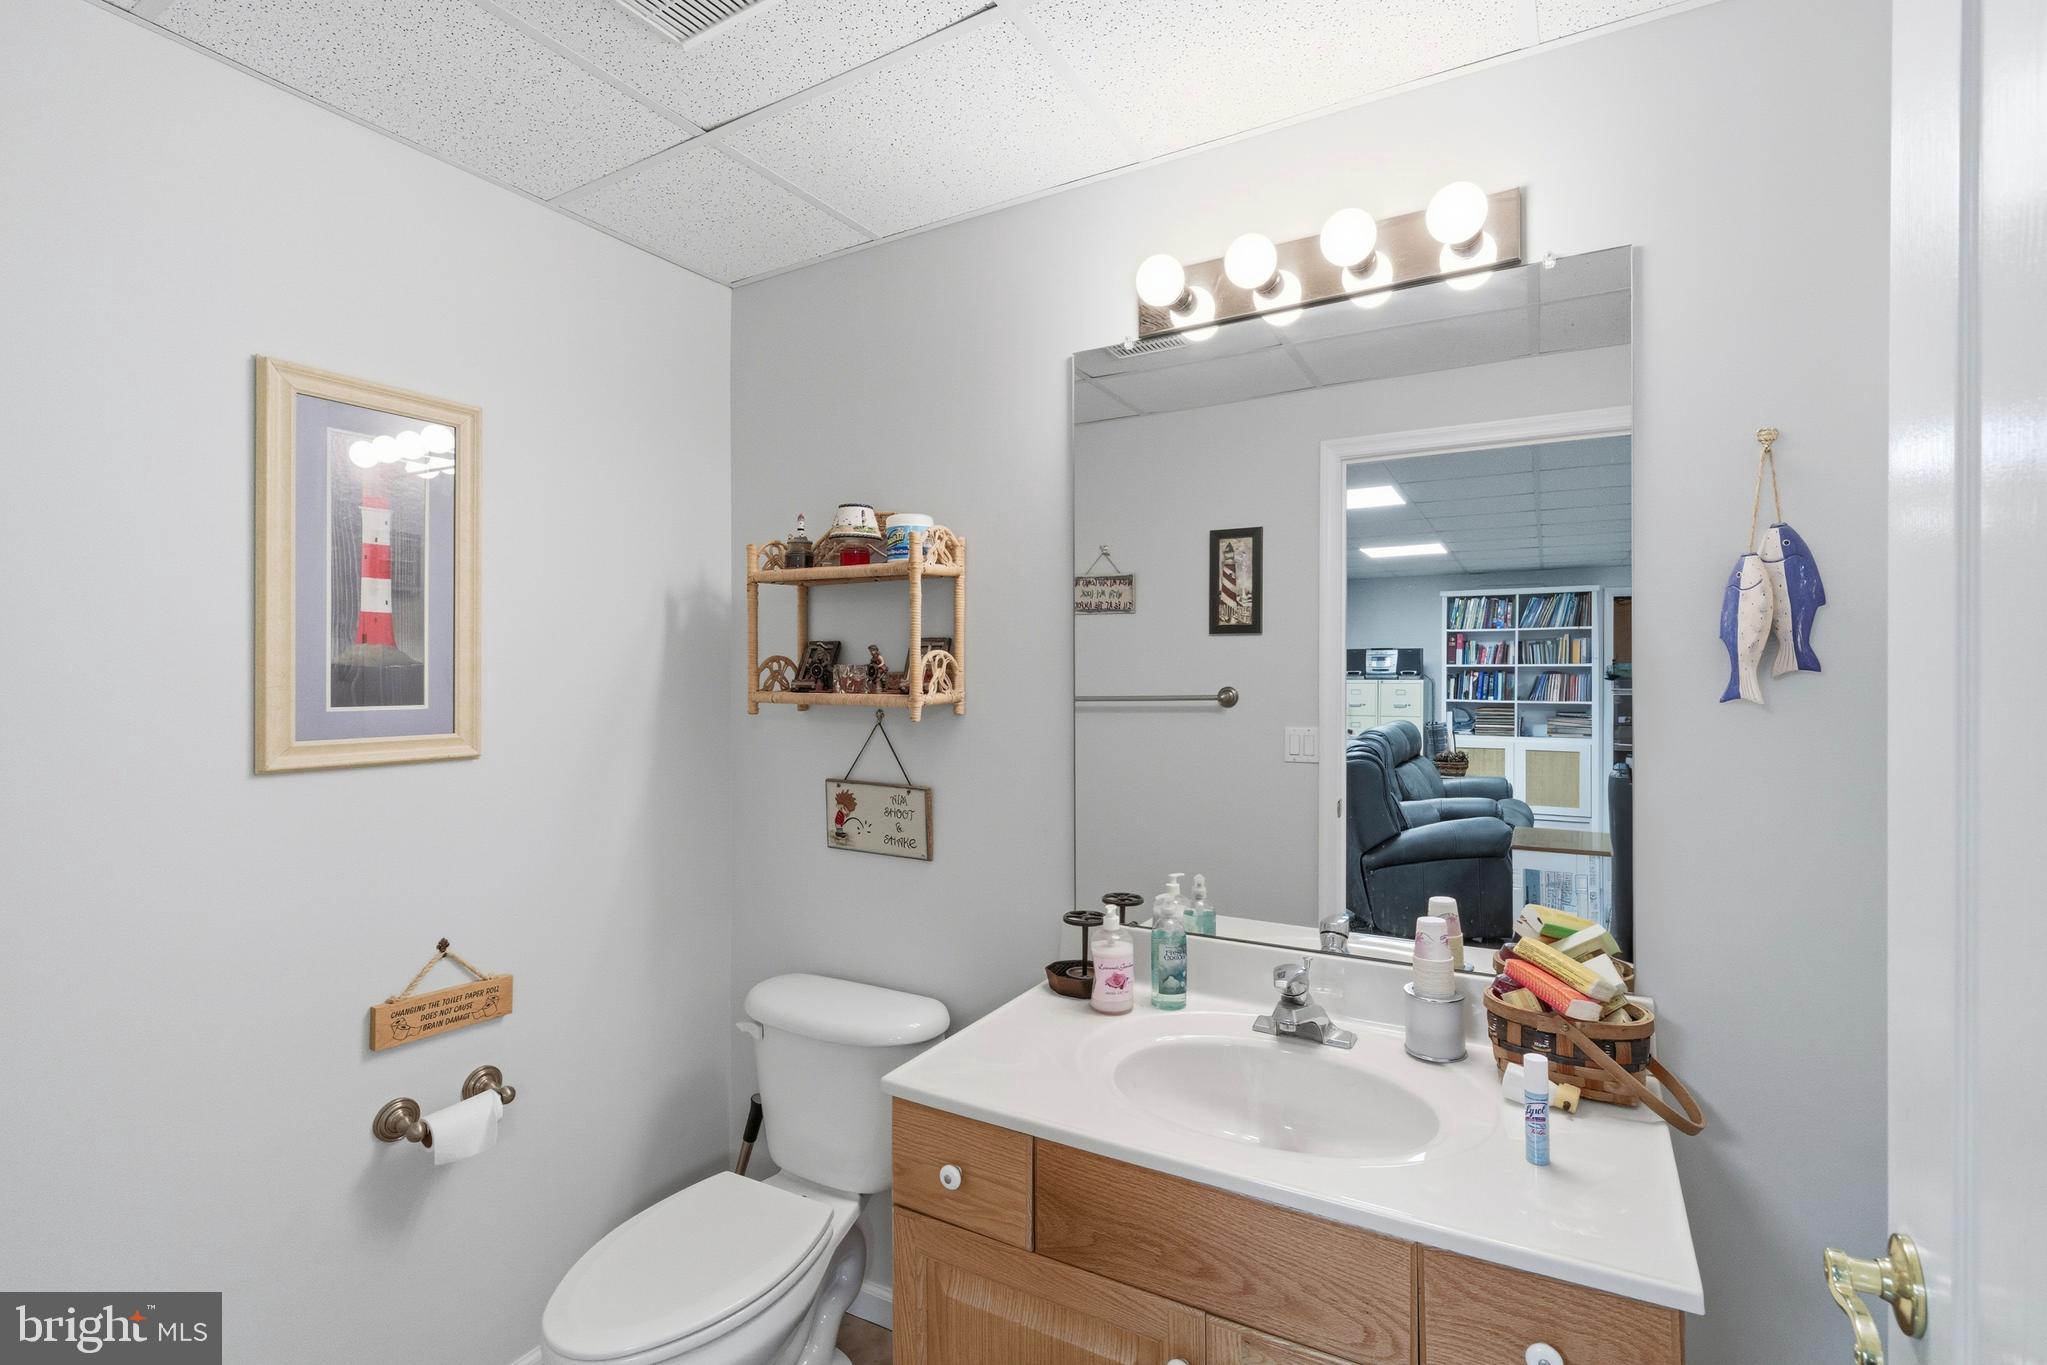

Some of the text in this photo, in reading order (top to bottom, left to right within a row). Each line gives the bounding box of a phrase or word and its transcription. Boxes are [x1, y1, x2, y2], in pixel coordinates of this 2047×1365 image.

[883, 807, 916, 821] SHOOT
[390, 985, 500, 1019] CHANGING THE TOILET PAPER ROLL
[420, 1001, 474, 1021] DOES NOT CAUSE
[422, 1011, 471, 1032] BRAIN DAMAGE
